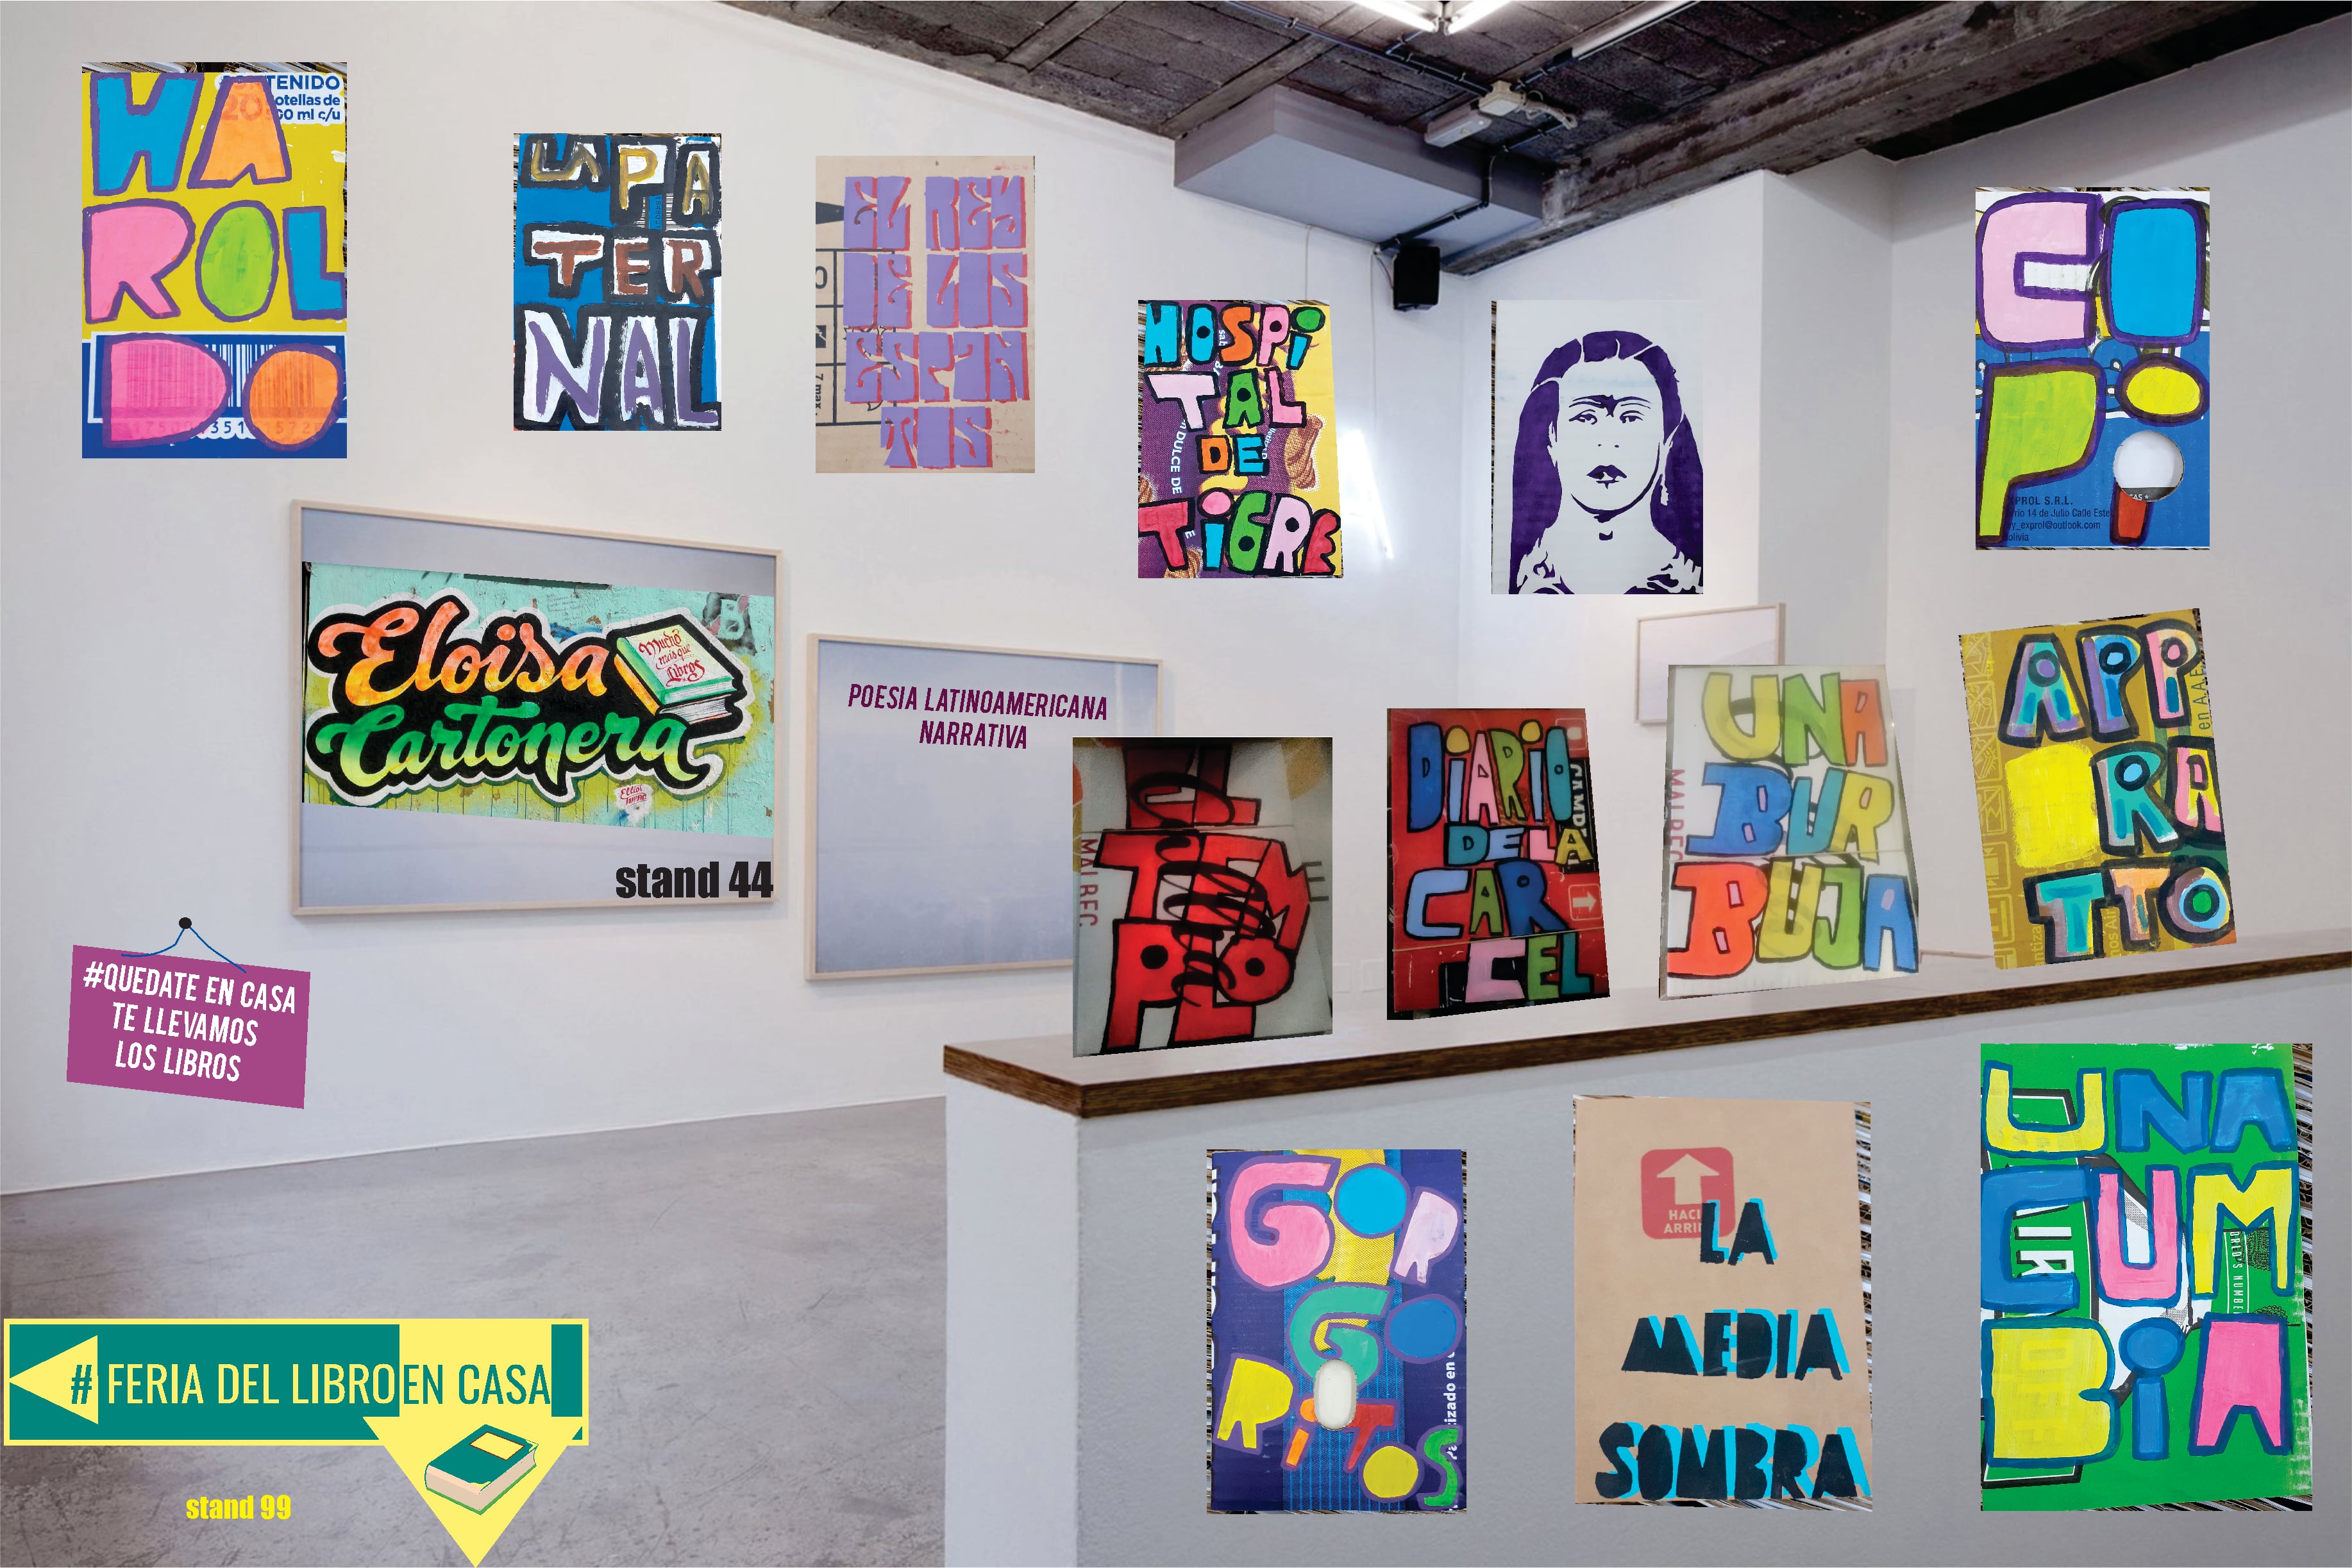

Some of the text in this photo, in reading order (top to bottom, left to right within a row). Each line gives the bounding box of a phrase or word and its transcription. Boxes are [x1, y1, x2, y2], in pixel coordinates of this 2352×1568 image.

[297, 108, 314, 121] ml
[318, 107, 340, 122] c/u
[323, 94, 340, 106] de
[610, 135, 721, 227] PA
[82, 198, 347, 324] ROL
[523, 222, 721, 306] TER
[103, 332, 345, 451] DO
[514, 303, 721, 431] NAL
[1144, 367, 1306, 432] TAL
[1170, 431, 1186, 472] DULCE
[1171, 477, 1182, 495] DE
[1196, 433, 1270, 476] DE
[2028, 508, 2037, 517] 14
[2039, 508, 2049, 517] de
[2051, 508, 2070, 517] Julio
[2072, 508, 2090, 517] Calle
[2044, 496, 2073, 505] S.R.L.
[317, 696, 698, 788] Cartonera
[1701, 672, 1888, 767] UNA
[2197, 712, 2210, 730] en
[1685, 762, 1894, 865] BUR
[1404, 858, 1570, 940] CAR
[1667, 856, 1919, 980] BUJA
[2023, 856, 2237, 965] TTO
[1464, 933, 1595, 1004] CEL
[1983, 1060, 2299, 1159] UNA
[1225, 1155, 1461, 1292] GOR
[1664, 1222, 1702, 1234] ARRI
[1668, 1209, 1702, 1221] HACI
[1699, 1197, 1778, 1266] LA
[1981, 1160, 2301, 1313] CUM
[2232, 1275, 2244, 1314] NUMBE
[1445, 1361, 1456, 1380] en
[1621, 1308, 1852, 1381] MEDIA
[1595, 1421, 1871, 1501] SOMBRA
